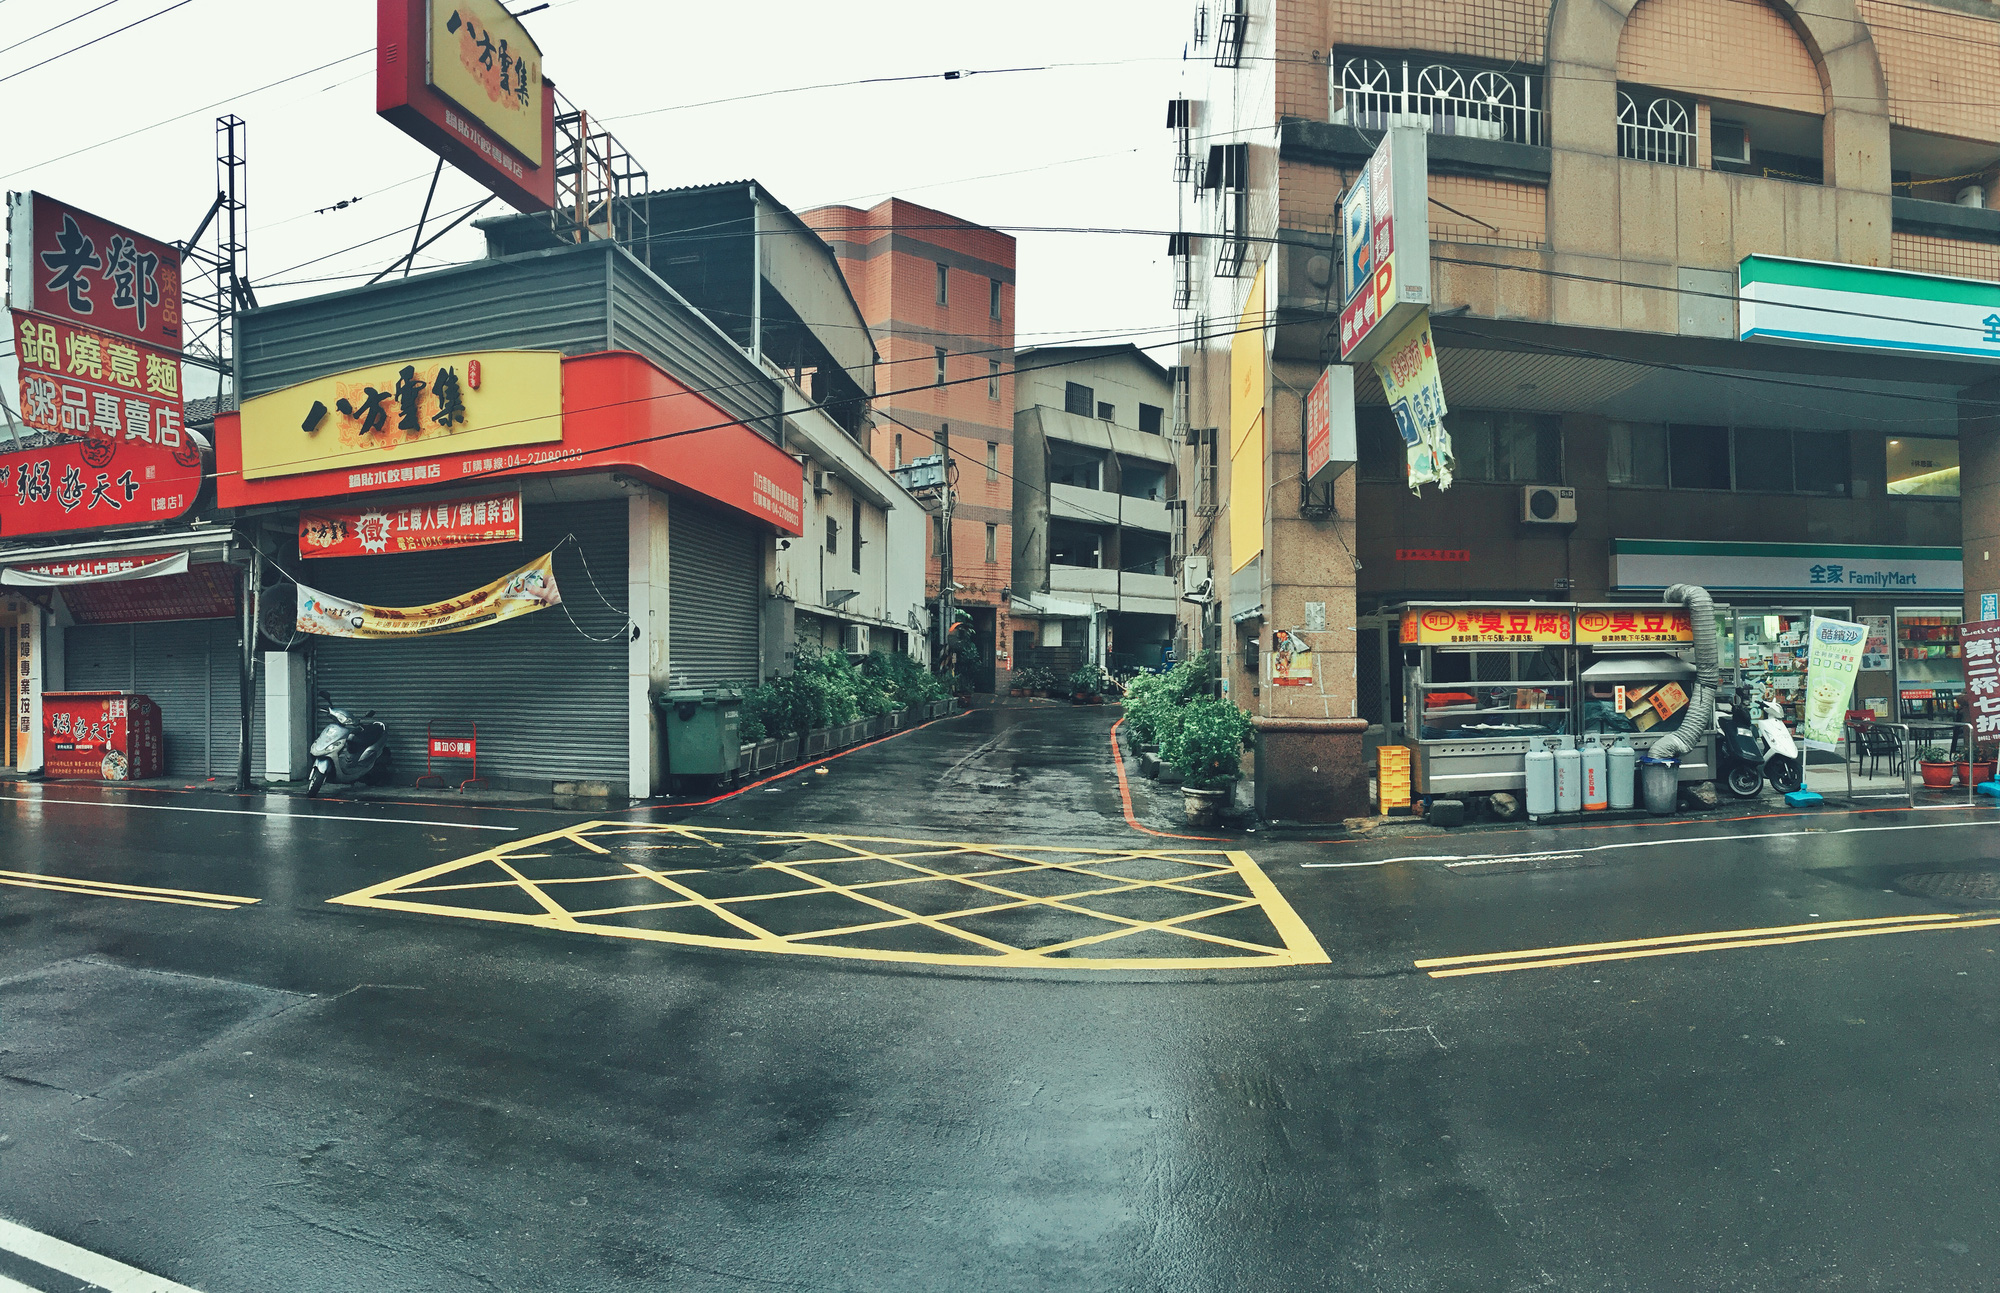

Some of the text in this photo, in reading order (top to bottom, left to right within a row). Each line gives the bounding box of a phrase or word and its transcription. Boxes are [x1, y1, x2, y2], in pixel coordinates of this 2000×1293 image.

[446, 9, 529, 107] 八方雲集
[445, 109, 523, 179] 鍋貼水餃專賣店
[40, 212, 160, 332] 老鄧
[1346, 184, 1367, 297] P
[1376, 261, 1393, 319] P
[19, 318, 179, 398] 鍋燒意麵
[23, 375, 181, 448] 粥品專賣店
[301, 365, 466, 435] 八方雲集
[348, 463, 441, 488] 鍋貼水餃專賣店
[362, 519, 383, 543] 徵
[396, 497, 515, 532] 正職人員/儲備幹部
[1810, 564, 1917, 588] 全家 FamilyMart
[1428, 615, 1450, 626] 可口
[1479, 611, 1559, 635] 臭豆腐
[1585, 616, 1604, 627] 可口
[1821, 628, 1858, 641] 酷繽沙
[20, 623, 30, 733] 視障專業按摩
[1964, 639, 2000, 733] 第二杯七折
